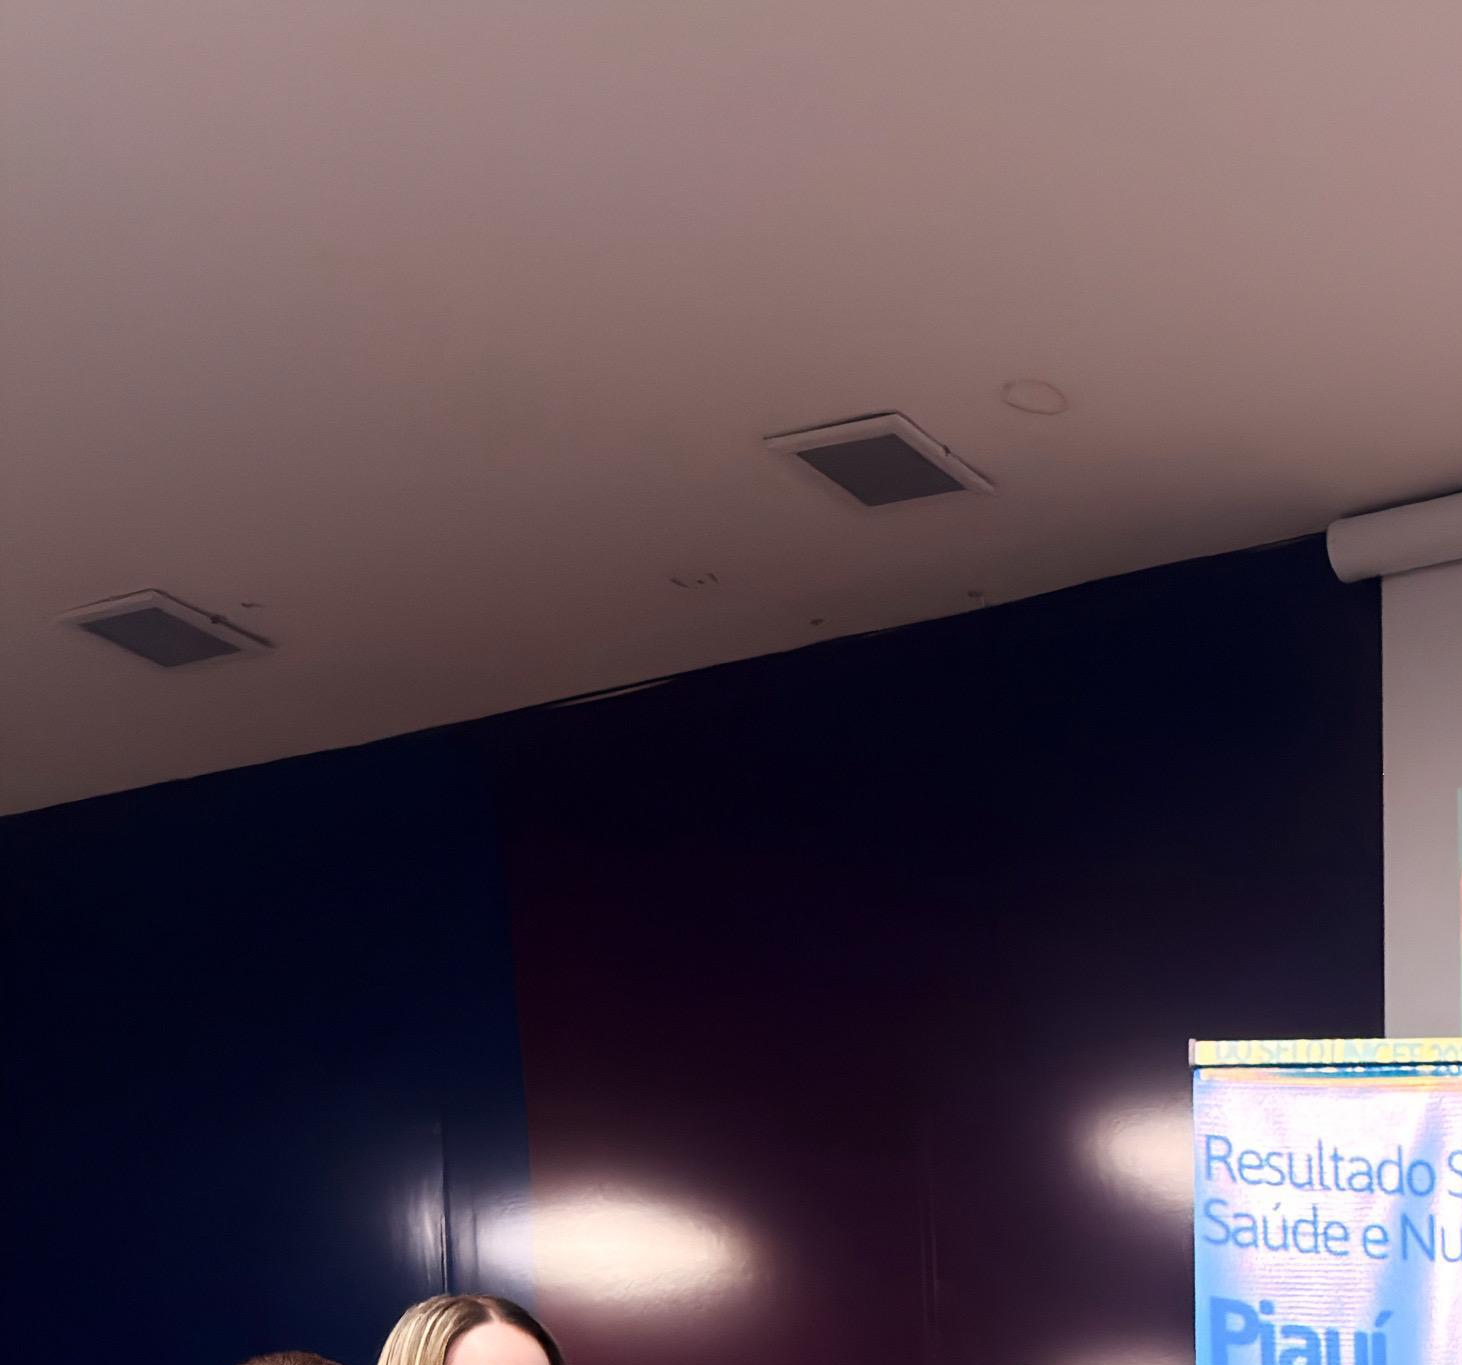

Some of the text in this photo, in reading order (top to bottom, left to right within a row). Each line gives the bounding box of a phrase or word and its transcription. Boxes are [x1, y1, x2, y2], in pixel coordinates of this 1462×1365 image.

[1205, 1133, 1436, 1197] Resultado
[1203, 1198, 1350, 1258] Saúde
[1363, 1225, 1390, 1259] e
